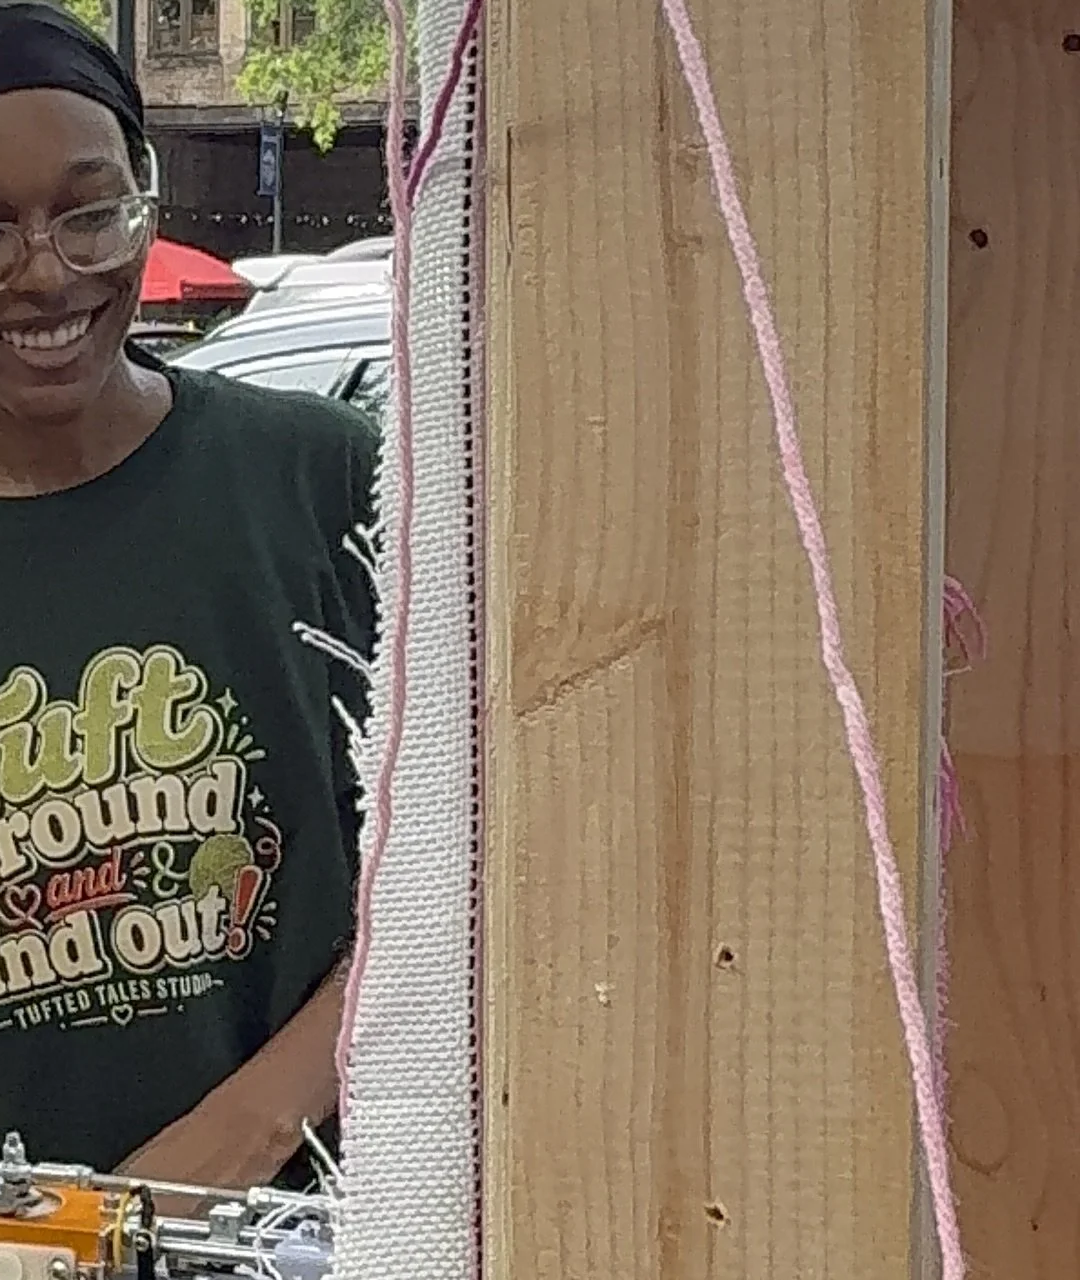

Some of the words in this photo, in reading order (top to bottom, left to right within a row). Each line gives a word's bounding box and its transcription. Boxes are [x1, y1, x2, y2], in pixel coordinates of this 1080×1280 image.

[47, 848, 126, 910] and
[114, 866, 262, 957] out!
[14, 989, 91, 1030] TUFTED
[95, 978, 152, 1006] TALES
